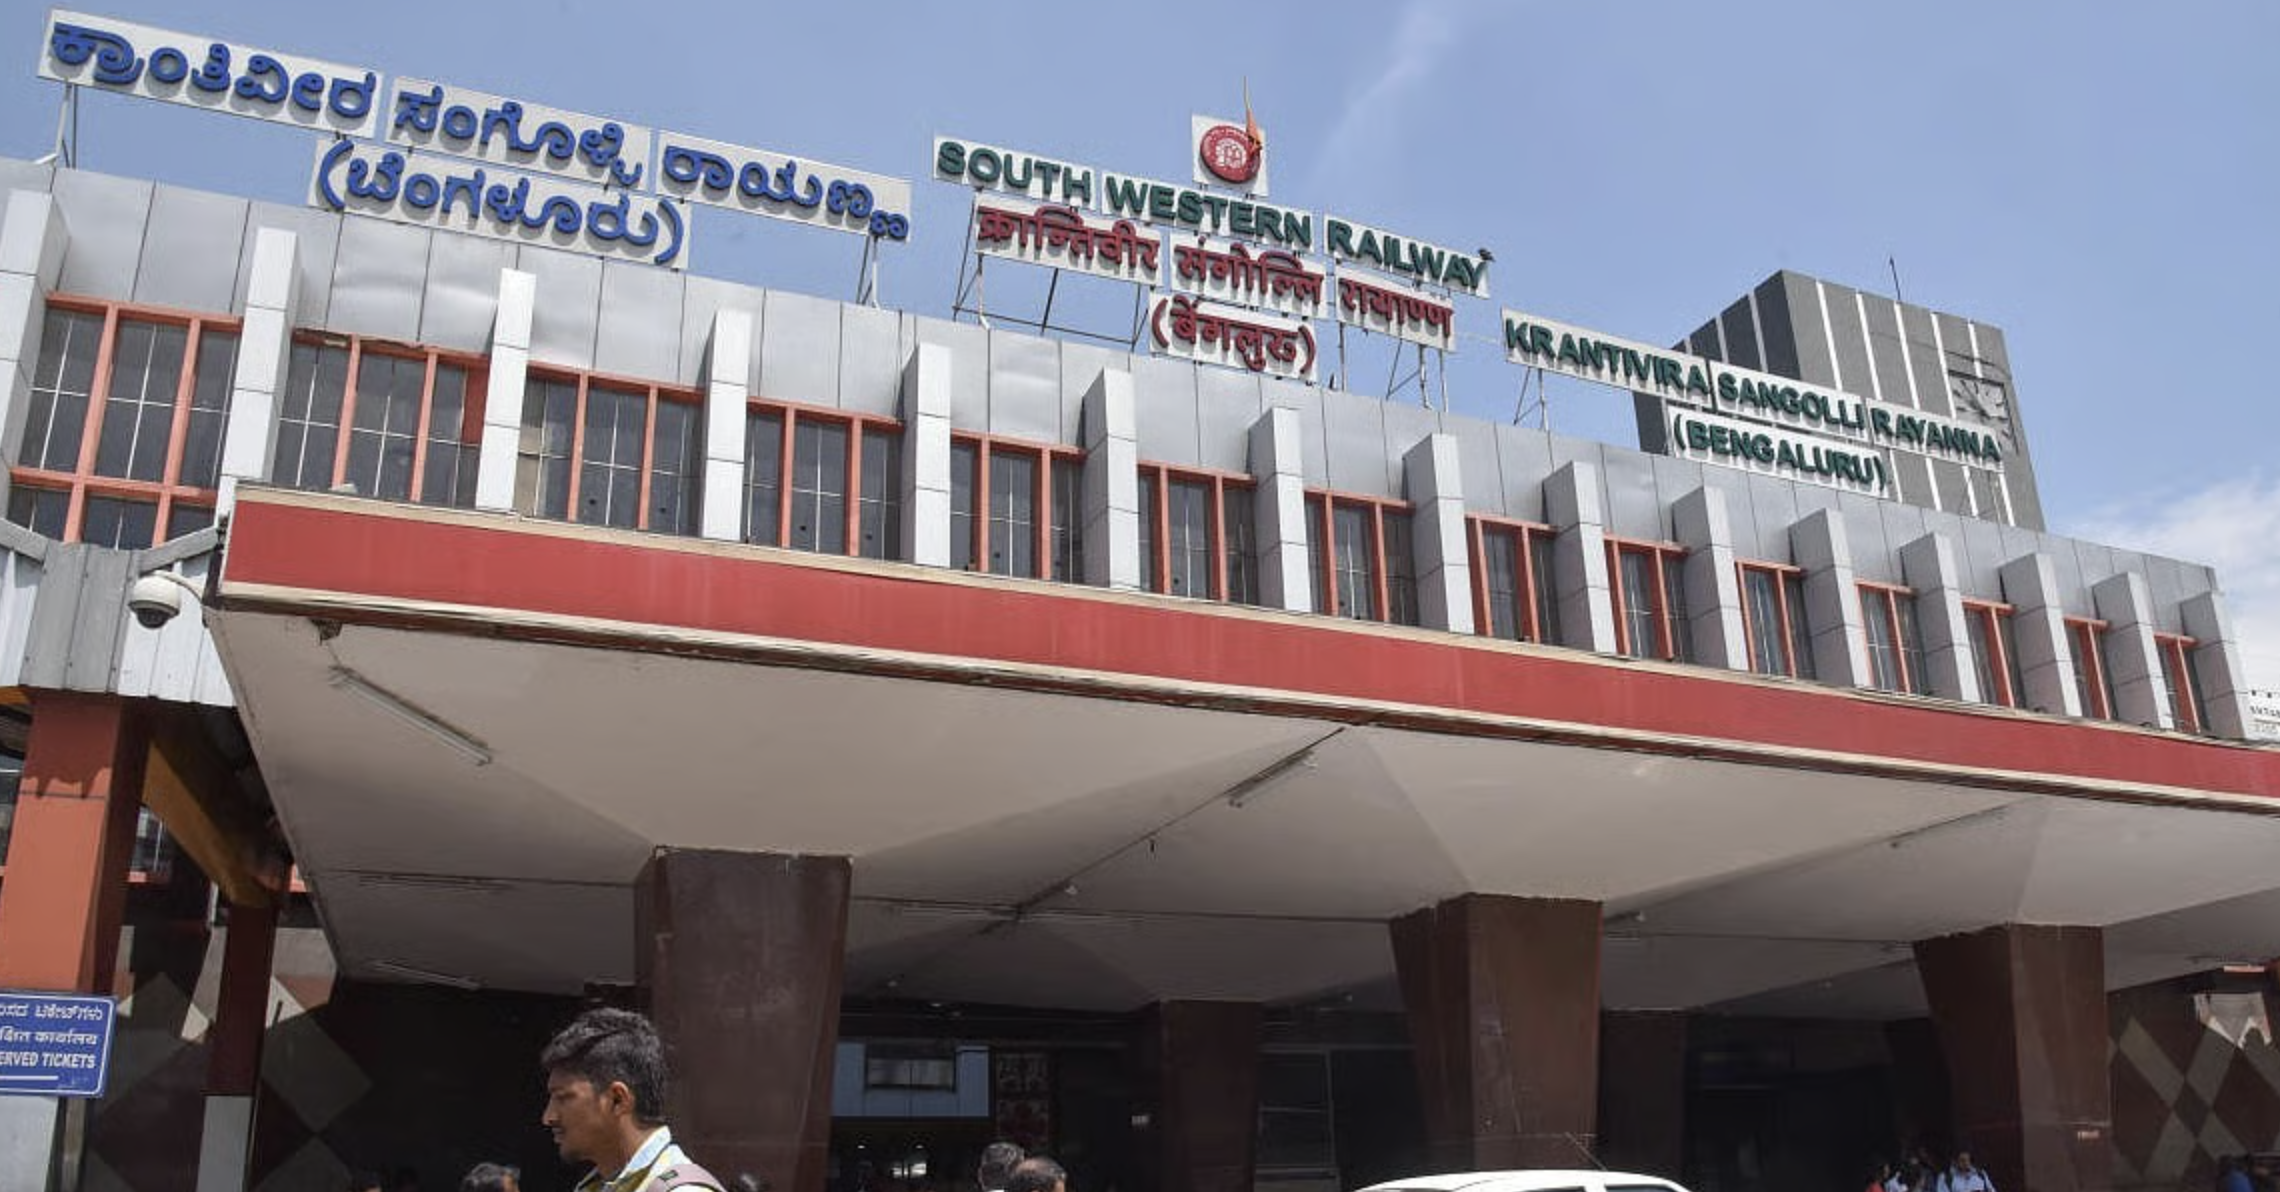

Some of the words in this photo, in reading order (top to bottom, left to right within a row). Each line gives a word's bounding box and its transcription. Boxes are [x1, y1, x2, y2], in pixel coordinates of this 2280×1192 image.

[52, 22, 376, 118] ಕ್ರಾಂತಿವೀರ
[395, 86, 642, 186] ಸಂಗೊಳ್ಳಿ
[663, 145, 908, 240] ರಾಯಣ್ಣ
[318, 139, 684, 264] (ಬೆಂಗಳೂರು)
[938, 141, 1091, 202] SOUTH
[1105, 176, 1312, 247] WESTERN
[1327, 219, 1488, 289] RAILWAY
[977, 205, 1160, 270] क्रान्तिवीर
[1505, 318, 1710, 395] KRANTIVIRA
[1717, 372, 1864, 431] SANGOLLI
[1870, 408, 2001, 462] RAYANNA
[1674, 413, 1887, 491] (BENGALURU)
[42, 1053, 97, 1069] TICKETS
